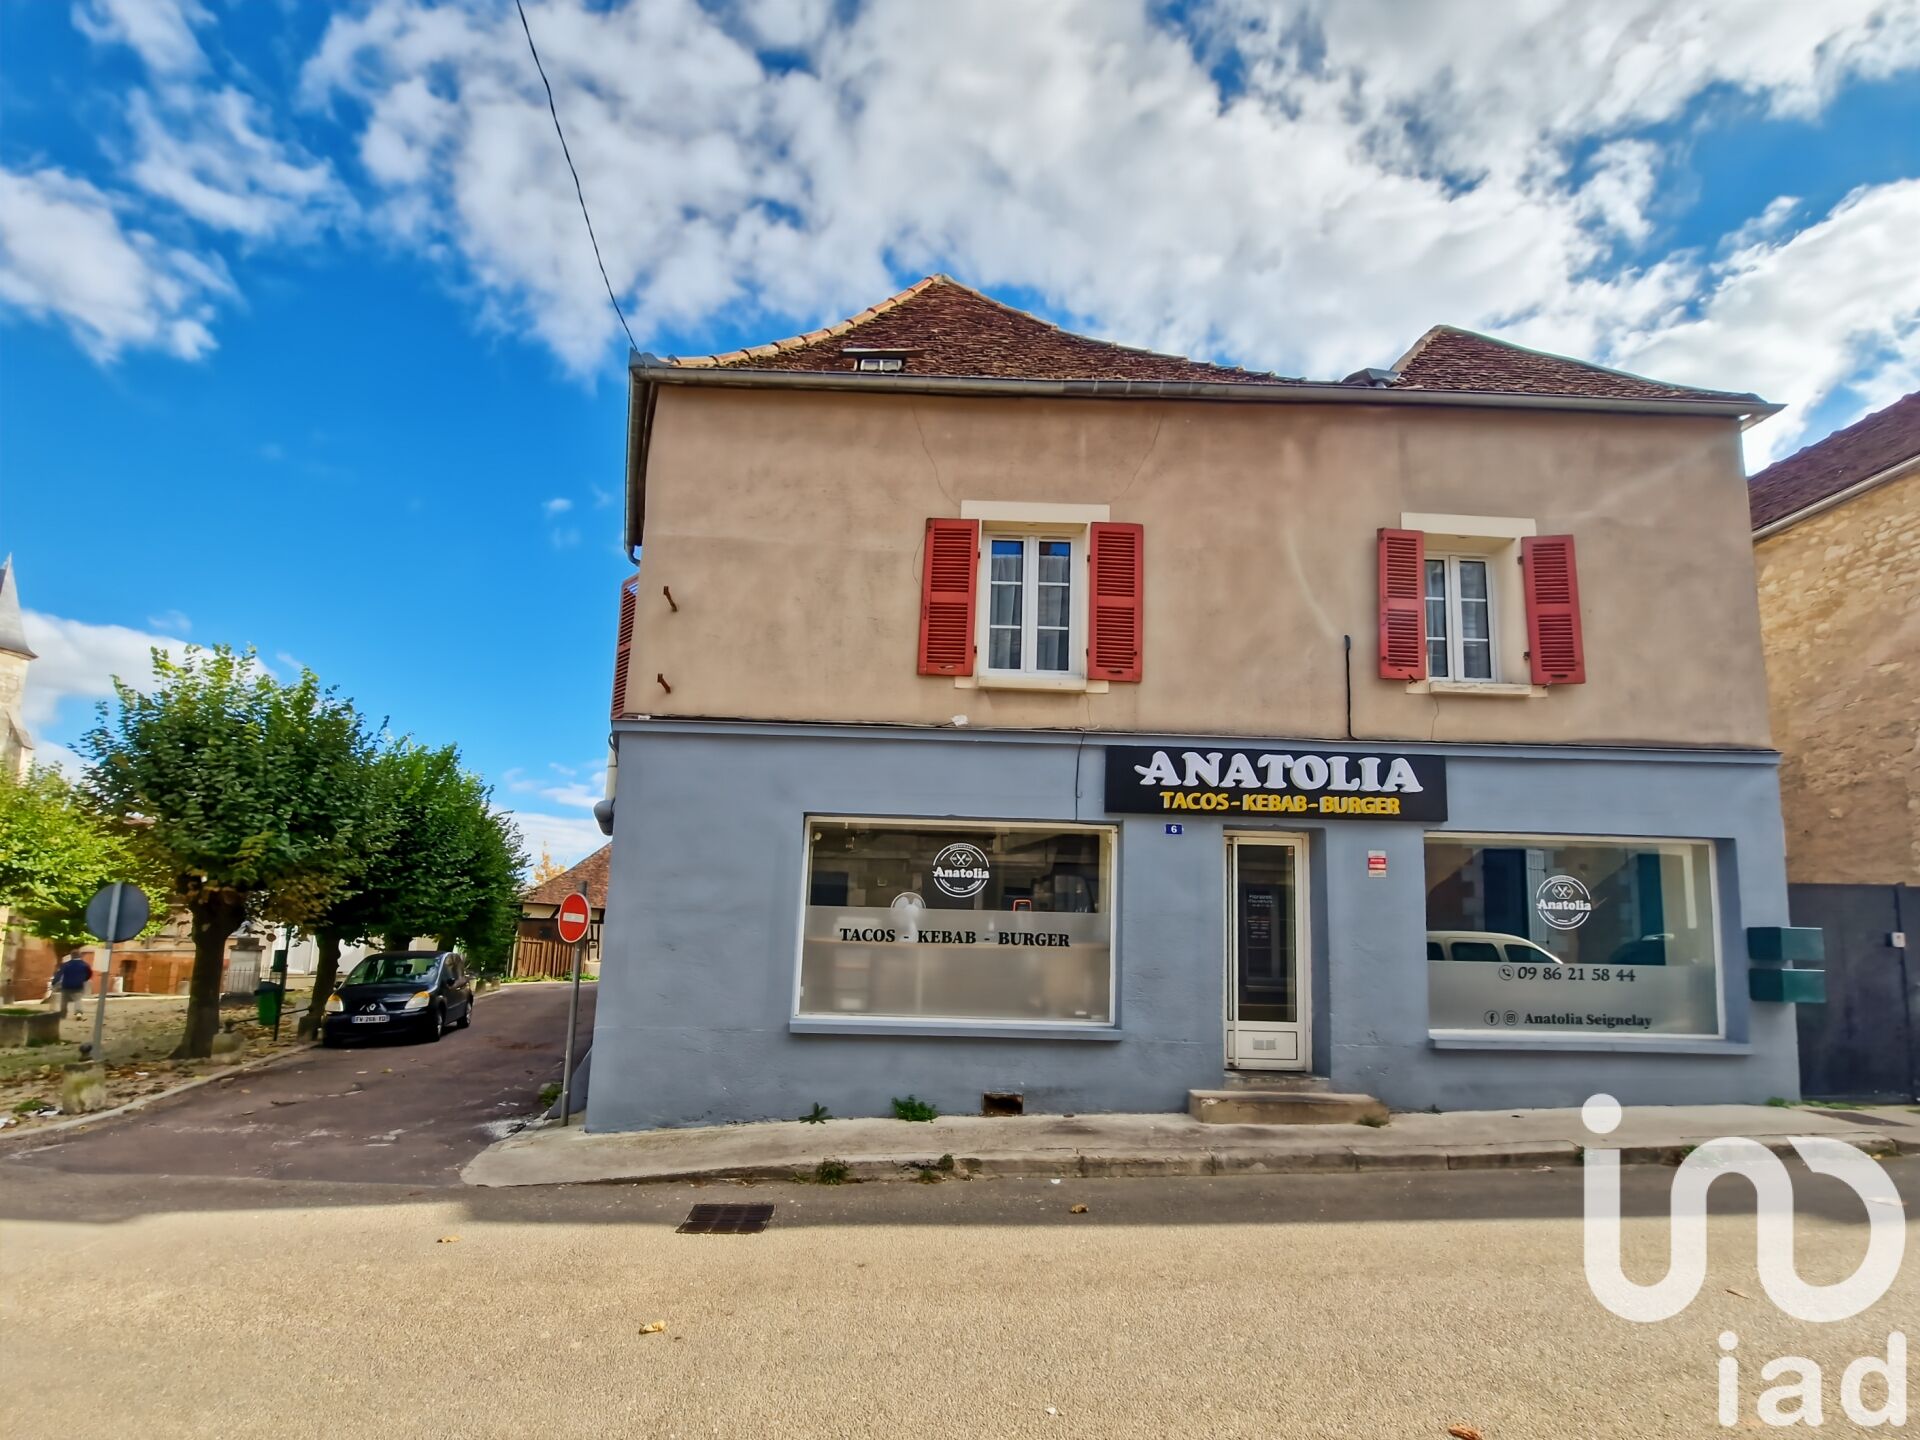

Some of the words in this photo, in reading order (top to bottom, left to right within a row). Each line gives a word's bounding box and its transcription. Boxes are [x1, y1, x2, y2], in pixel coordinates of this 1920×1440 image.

[1134, 750, 1424, 794] ANATOLIA
[1159, 791, 1229, 810] TACOS
[1242, 794, 1308, 813] KEBAB
[1319, 796, 1401, 815] BURGER
[1170, 825, 1178, 833] 6
[932, 866, 990, 879] Anatolia
[1536, 899, 1592, 911] Anatolia
[839, 928, 896, 943] TACOS
[917, 929, 977, 944] KEBAB
[998, 931, 1071, 947] BURGER
[1518, 966, 1538, 980] 09
[1543, 967, 1562, 981] 86
[1567, 967, 1585, 981] 21
[1591, 968, 1610, 981] 58
[1616, 969, 1636, 982] 44
[1524, 1012, 1583, 1025] Anatolia
[1585, 1014, 1653, 1030] Seignelay
